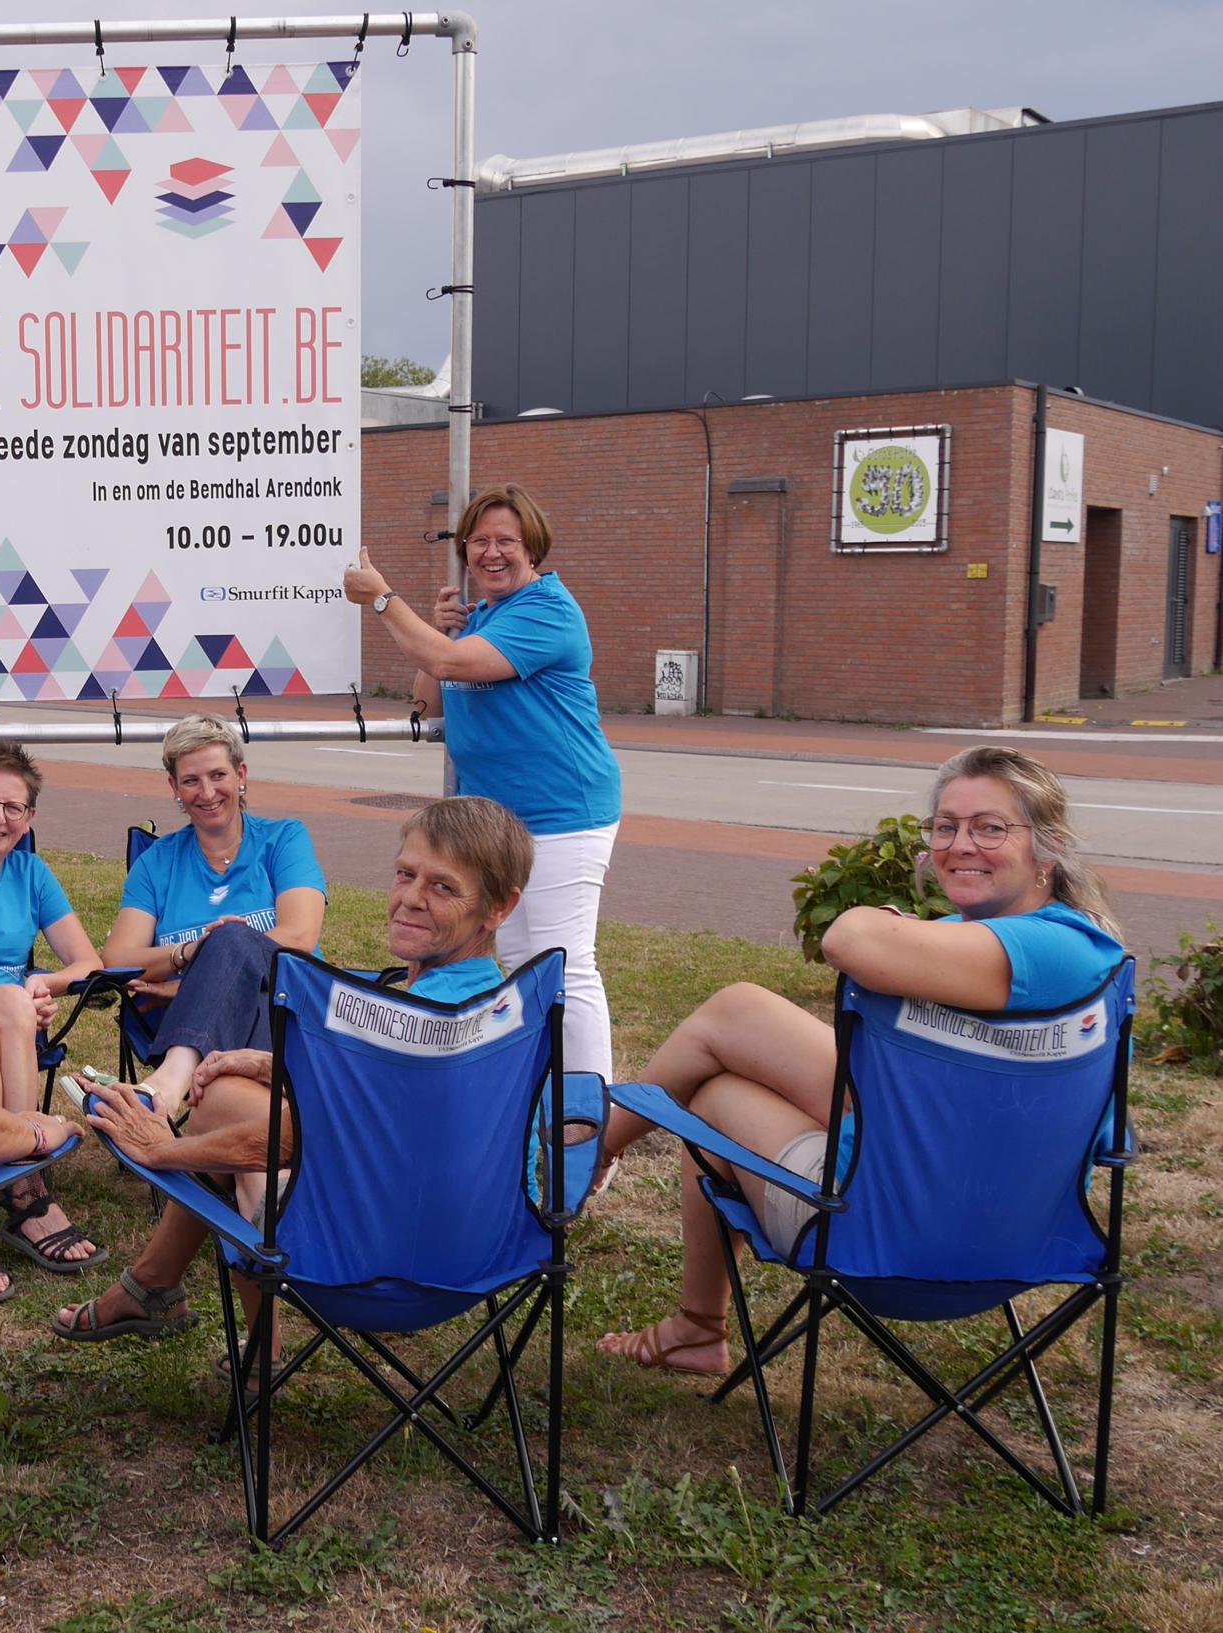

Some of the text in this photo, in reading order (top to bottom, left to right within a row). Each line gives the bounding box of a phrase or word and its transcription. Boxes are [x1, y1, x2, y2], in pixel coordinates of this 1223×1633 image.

[19, 307, 343, 409] SOLIDARITEIT.BE
[63, 427, 149, 464] zondag
[158, 433, 200, 457] van
[208, 424, 342, 463] september
[93, 476, 343, 501] In en om de Bemdhal Arendonk
[166, 525, 231, 550] 10.00
[264, 522, 343, 548] 19.00u
[228, 585, 342, 603] Smurfit Kappa
